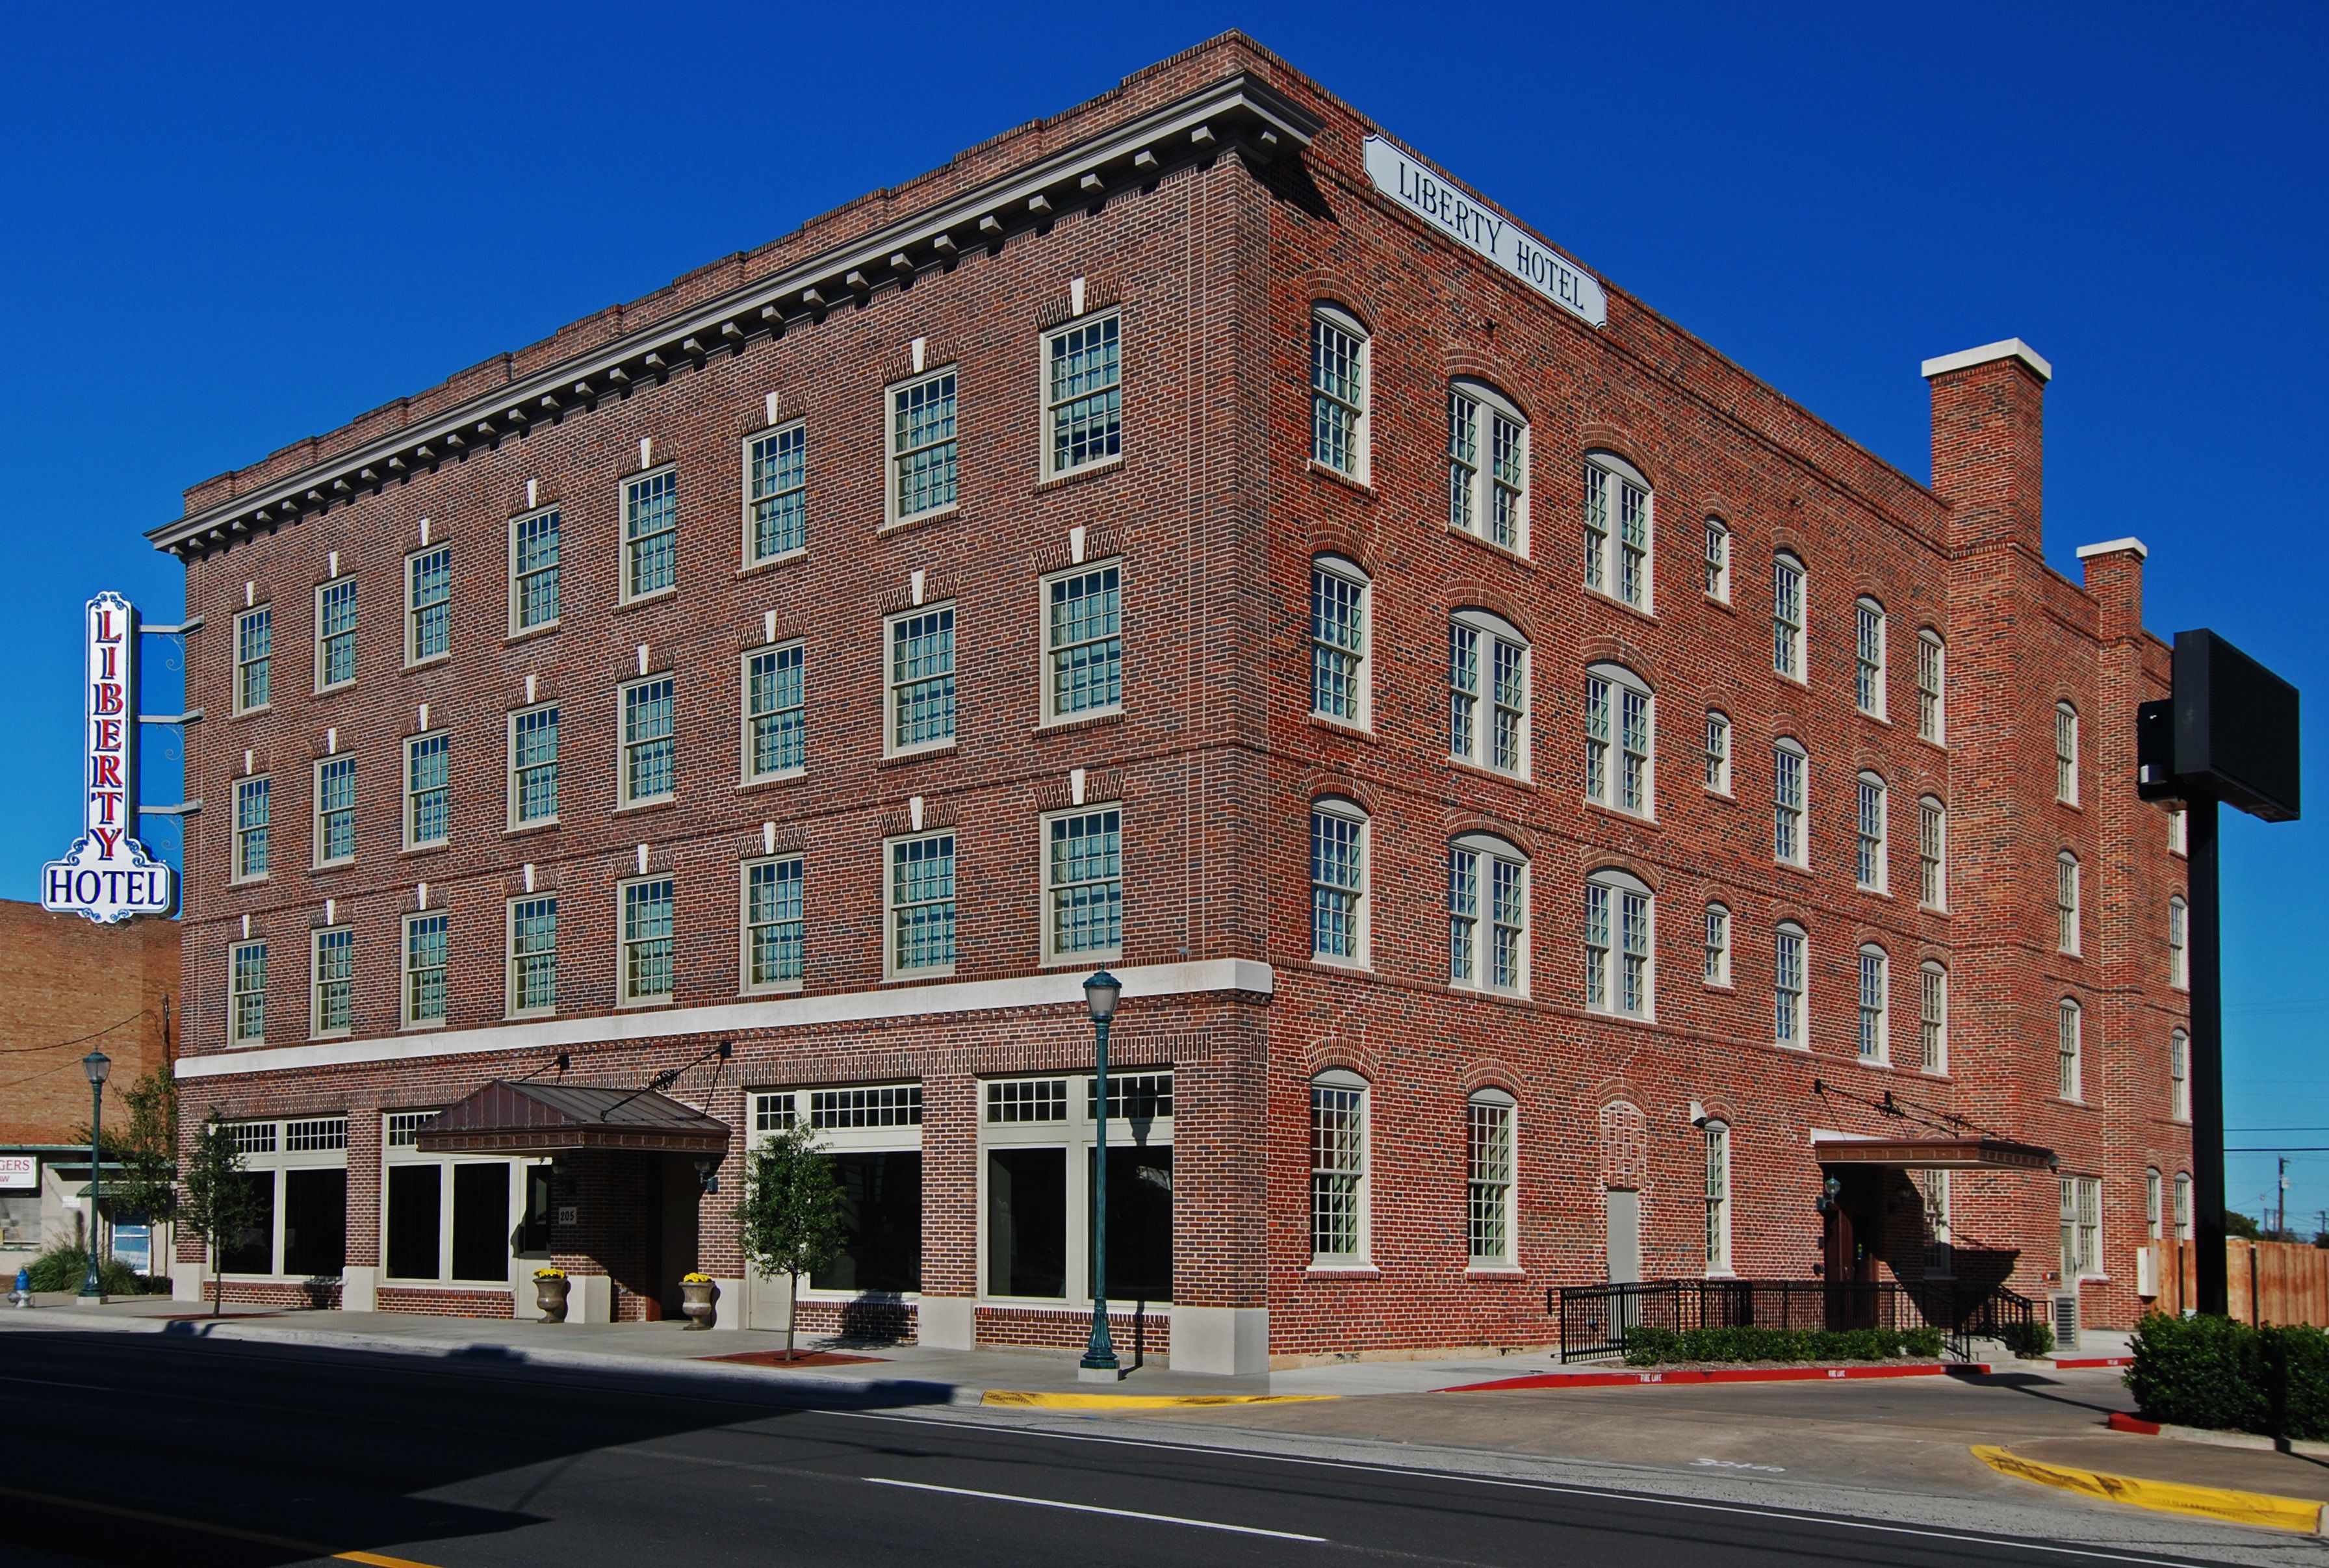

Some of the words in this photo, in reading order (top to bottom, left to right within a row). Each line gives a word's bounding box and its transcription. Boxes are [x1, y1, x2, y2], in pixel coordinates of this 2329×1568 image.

[1399, 161, 1504, 255] LIBERTY
[1517, 239, 1584, 311] HOTEL
[92, 610, 123, 860] LIBERTY
[49, 869, 165, 906] HOTEL
[561, 1210, 574, 1221] 205
